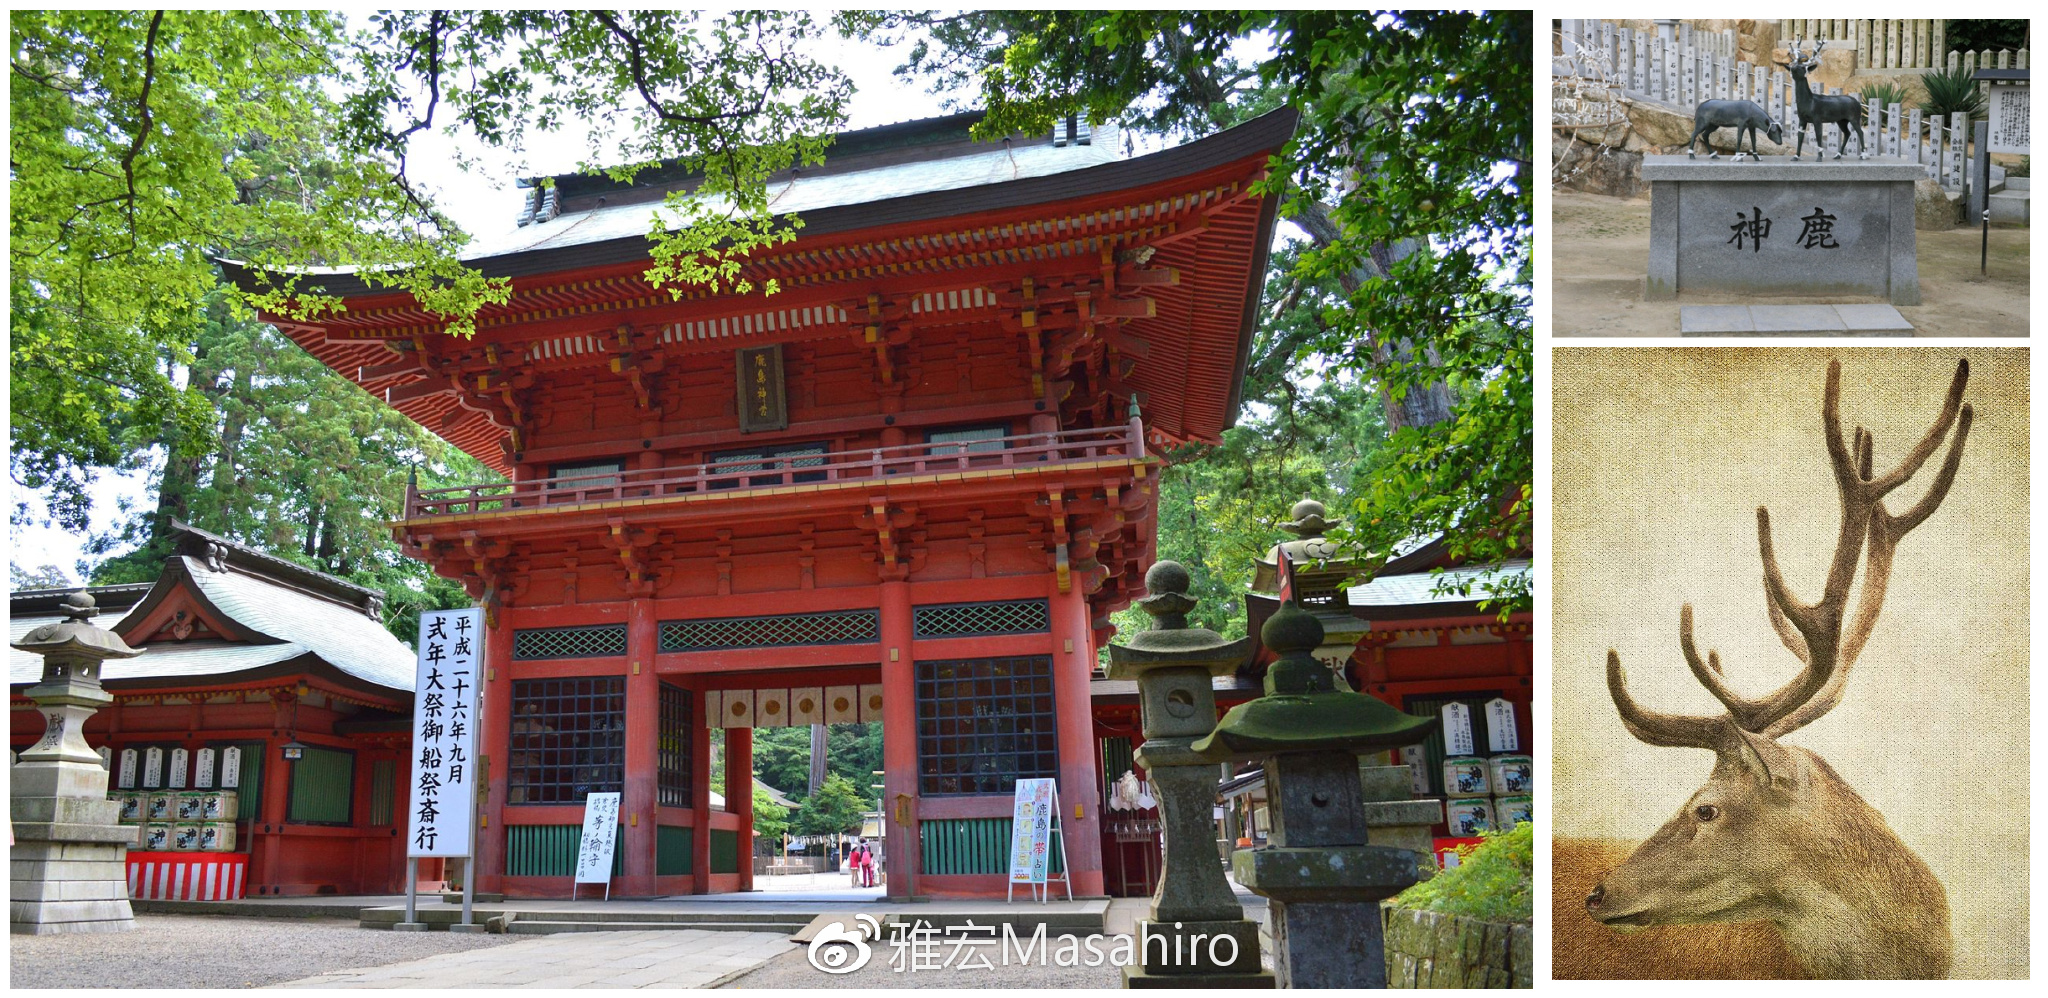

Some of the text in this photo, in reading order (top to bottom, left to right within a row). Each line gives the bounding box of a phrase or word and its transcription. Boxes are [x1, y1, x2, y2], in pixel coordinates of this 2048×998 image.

[1727, 206, 1840, 253] 神鹿
[415, 616, 448, 851] 式年大祭御船祭斎行
[447, 616, 472, 784] 平成二十六年九月
